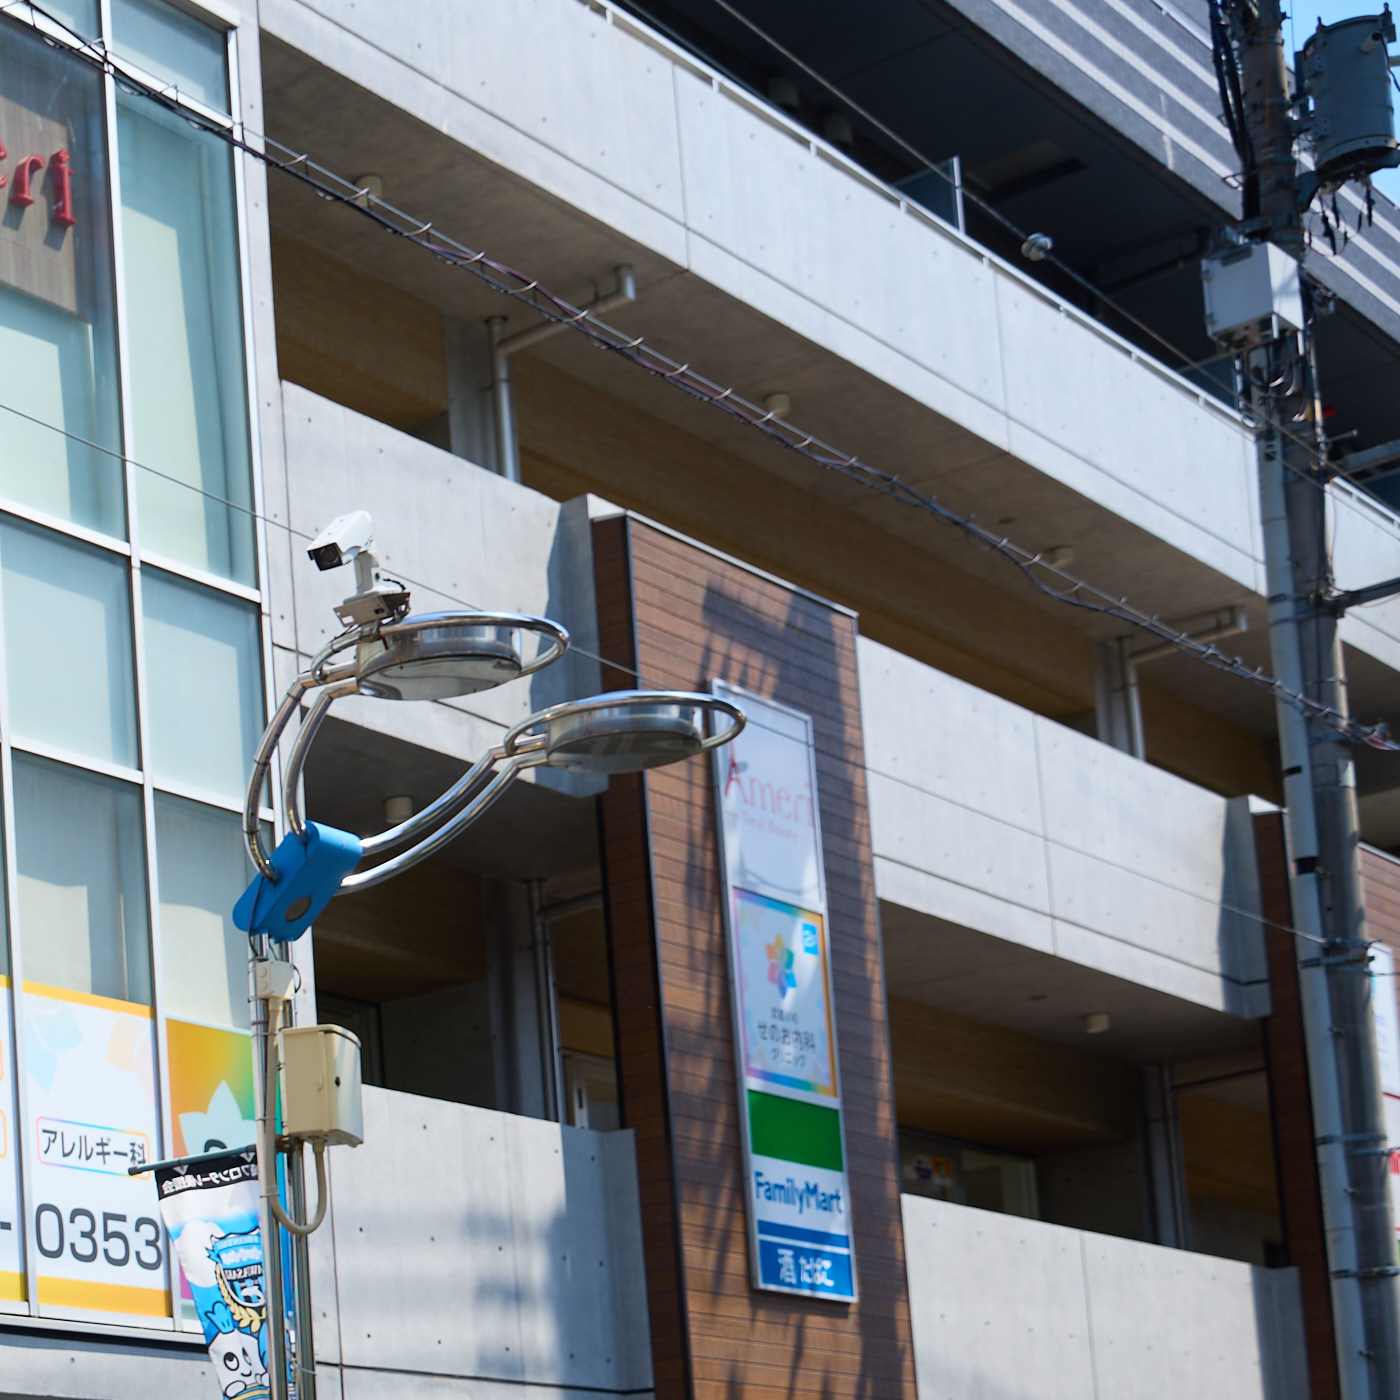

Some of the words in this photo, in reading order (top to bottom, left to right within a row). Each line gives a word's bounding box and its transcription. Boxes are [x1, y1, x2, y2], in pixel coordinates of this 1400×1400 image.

[41, 1124, 149, 1171] アレルギー科
[753, 1170, 843, 1216] FamilyMart
